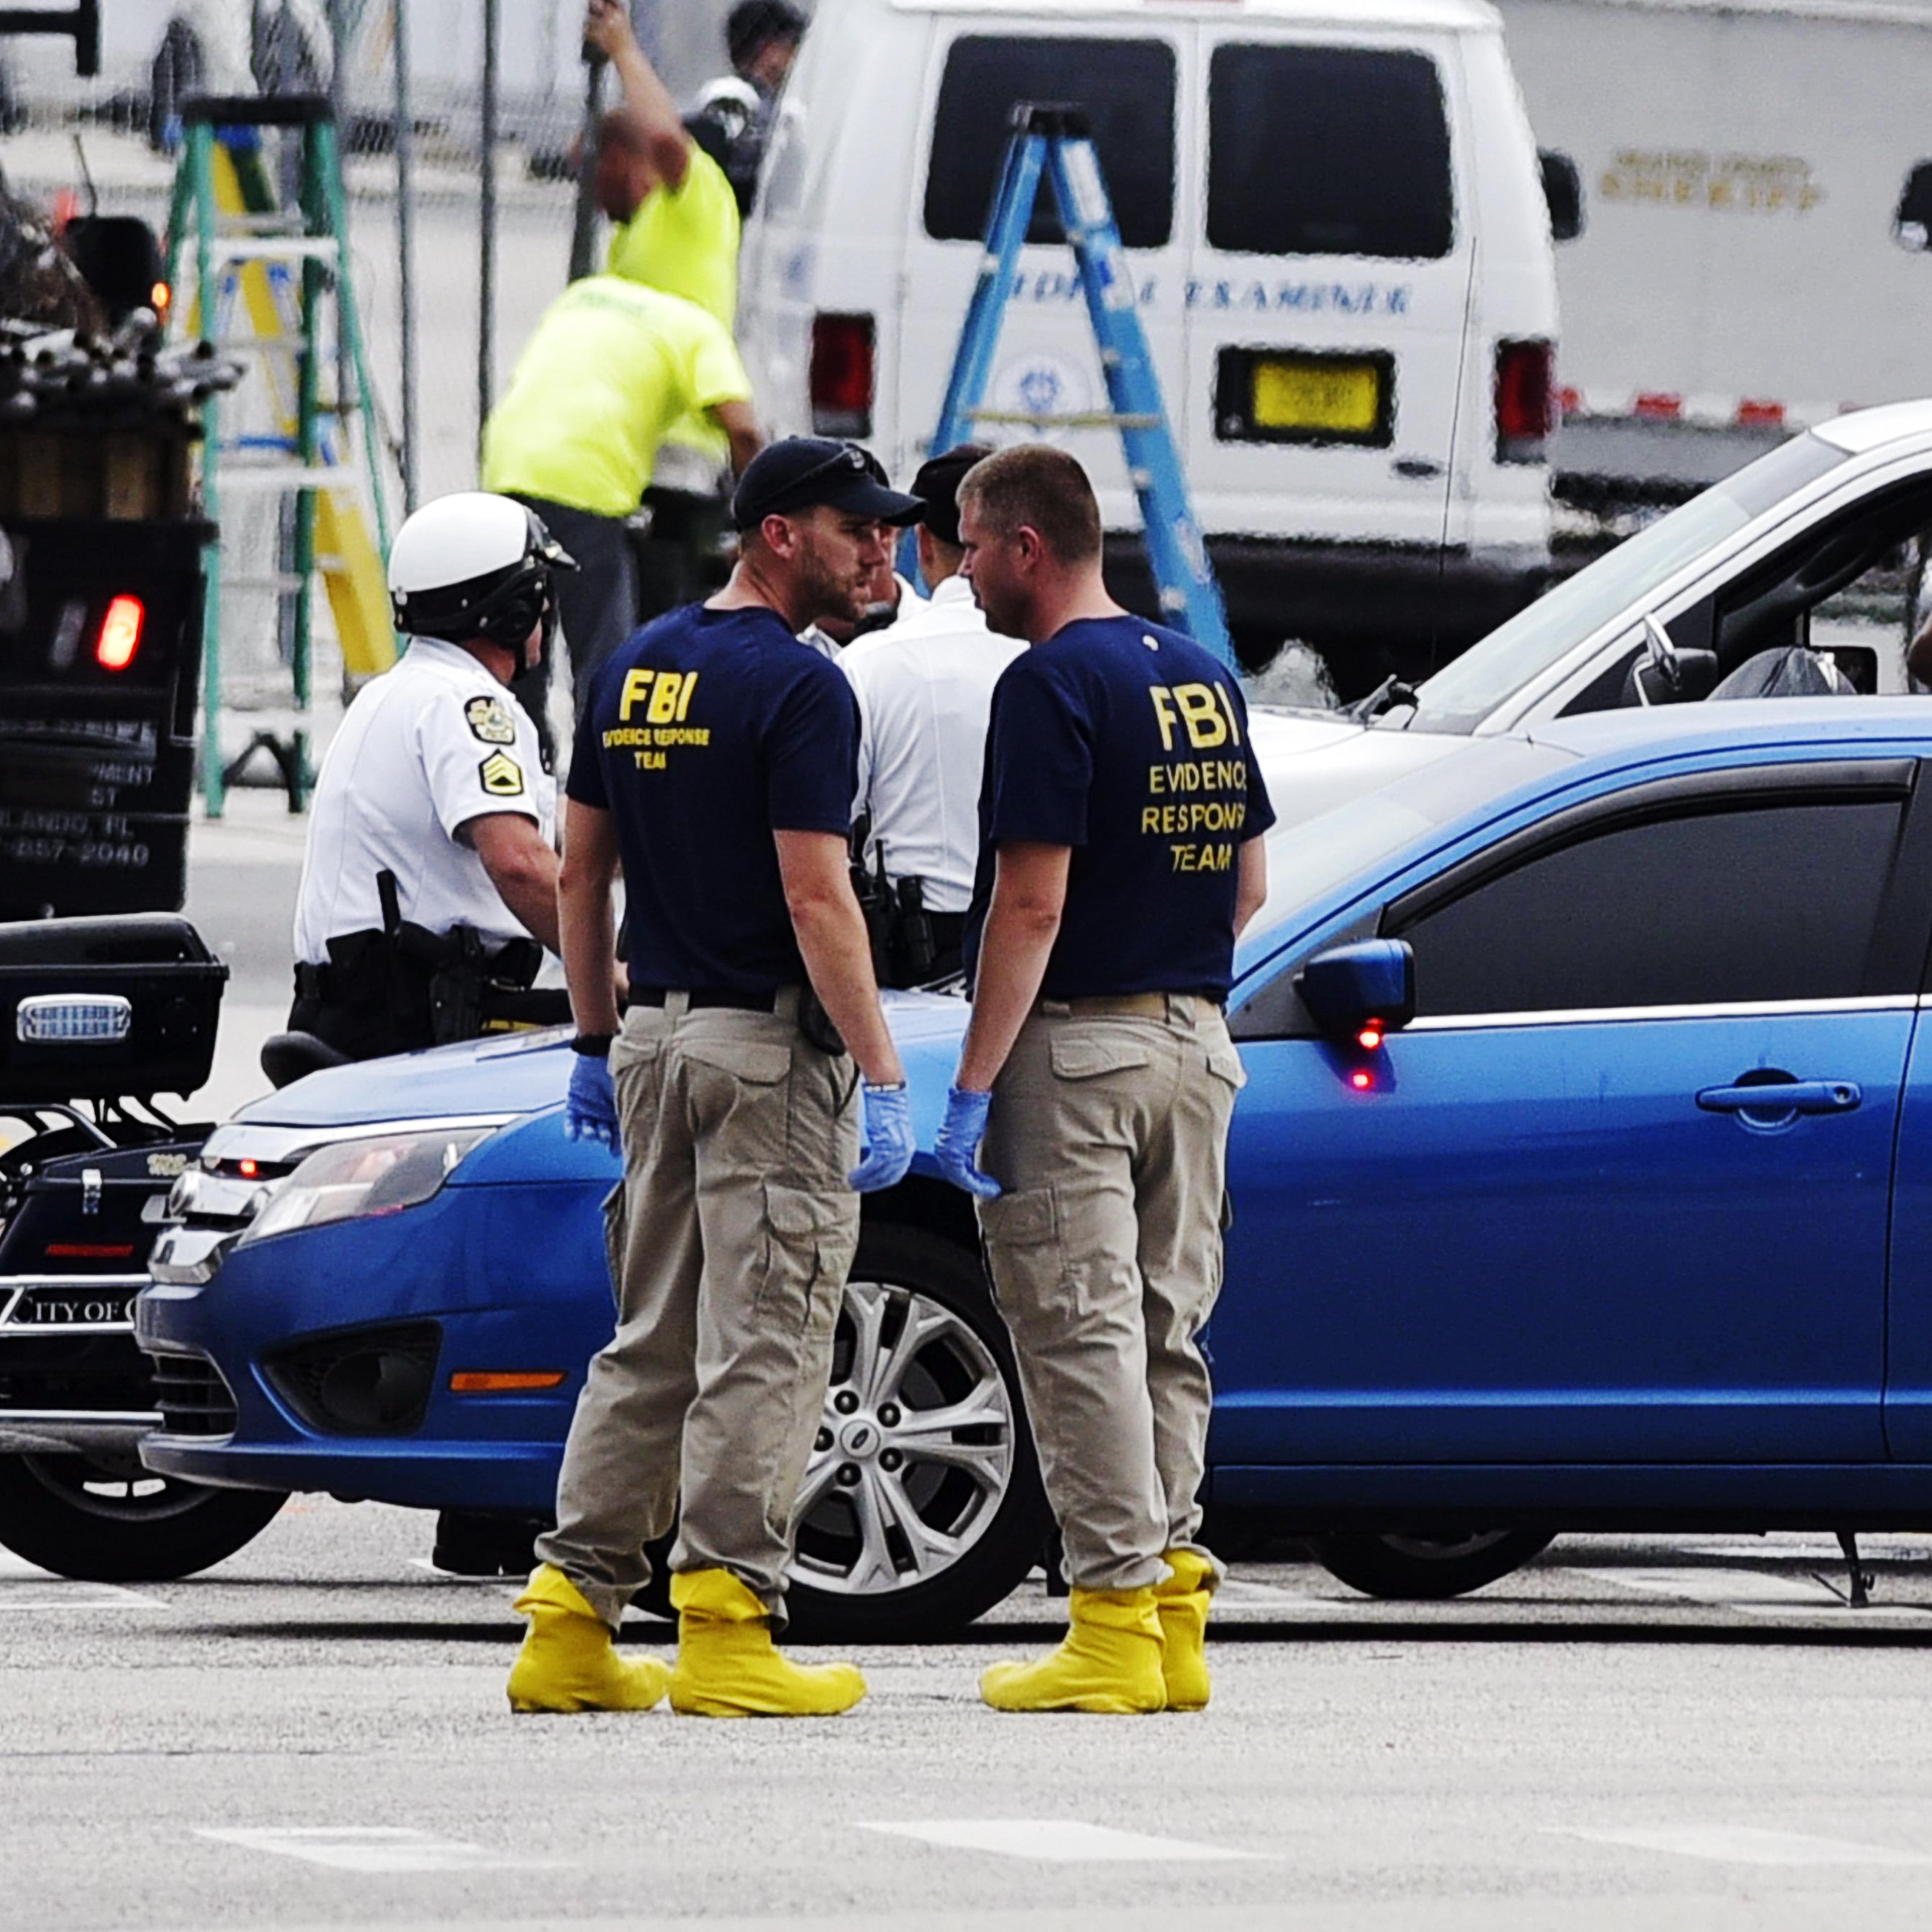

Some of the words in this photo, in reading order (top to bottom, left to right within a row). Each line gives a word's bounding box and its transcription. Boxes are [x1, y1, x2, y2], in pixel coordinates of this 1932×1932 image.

[1184, 279, 1409, 314] EXAMINER
[619, 668, 698, 723] FBI
[1149, 681, 1240, 751] FBI
[634, 751, 667, 769] TEAM
[1150, 760, 1247, 793] EVIDENC
[1170, 843, 1232, 873] TEAM
[84, 1302, 120, 1323] OF
